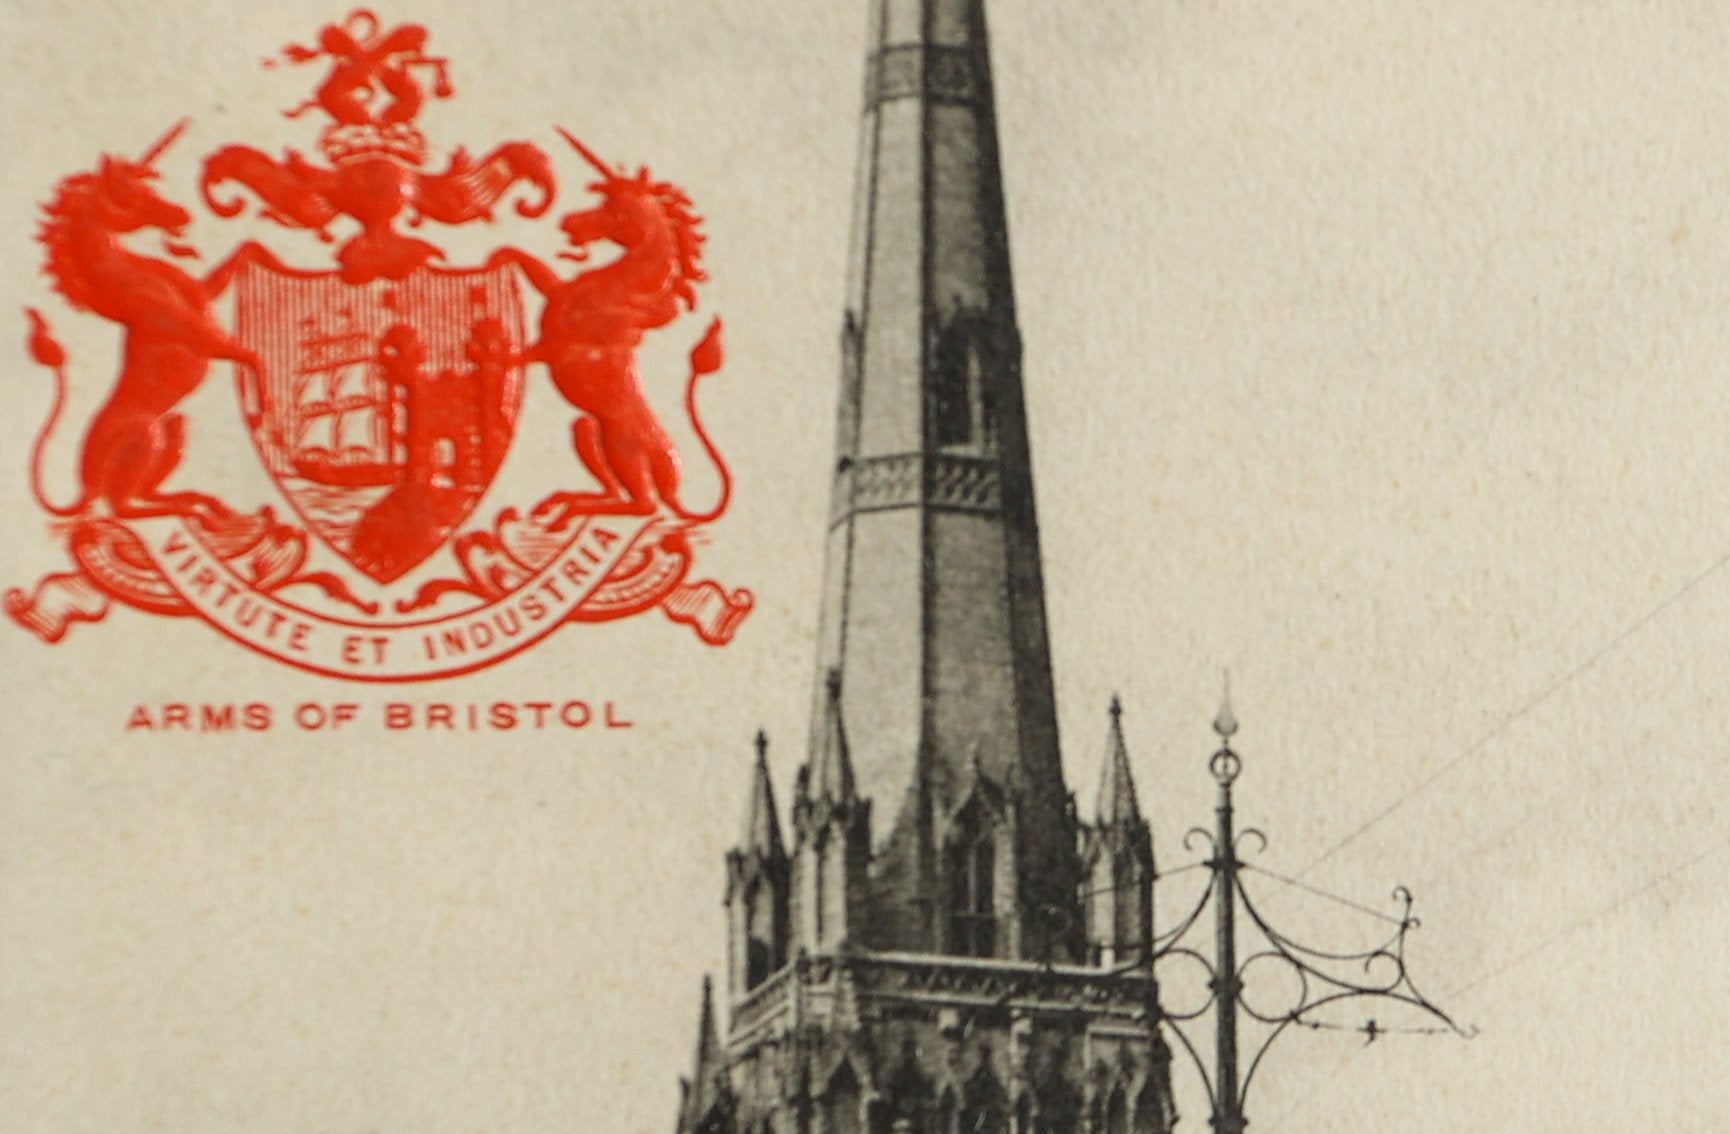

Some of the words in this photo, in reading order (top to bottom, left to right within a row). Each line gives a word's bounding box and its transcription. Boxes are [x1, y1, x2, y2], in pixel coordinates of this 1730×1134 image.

[163, 530, 315, 651] VIRTUTE
[341, 635, 390, 665] ET
[423, 528, 620, 660] INDUSTRIA
[125, 703, 273, 732] ARMS
[294, 703, 359, 731] OF
[384, 701, 634, 731] BRISTOL
